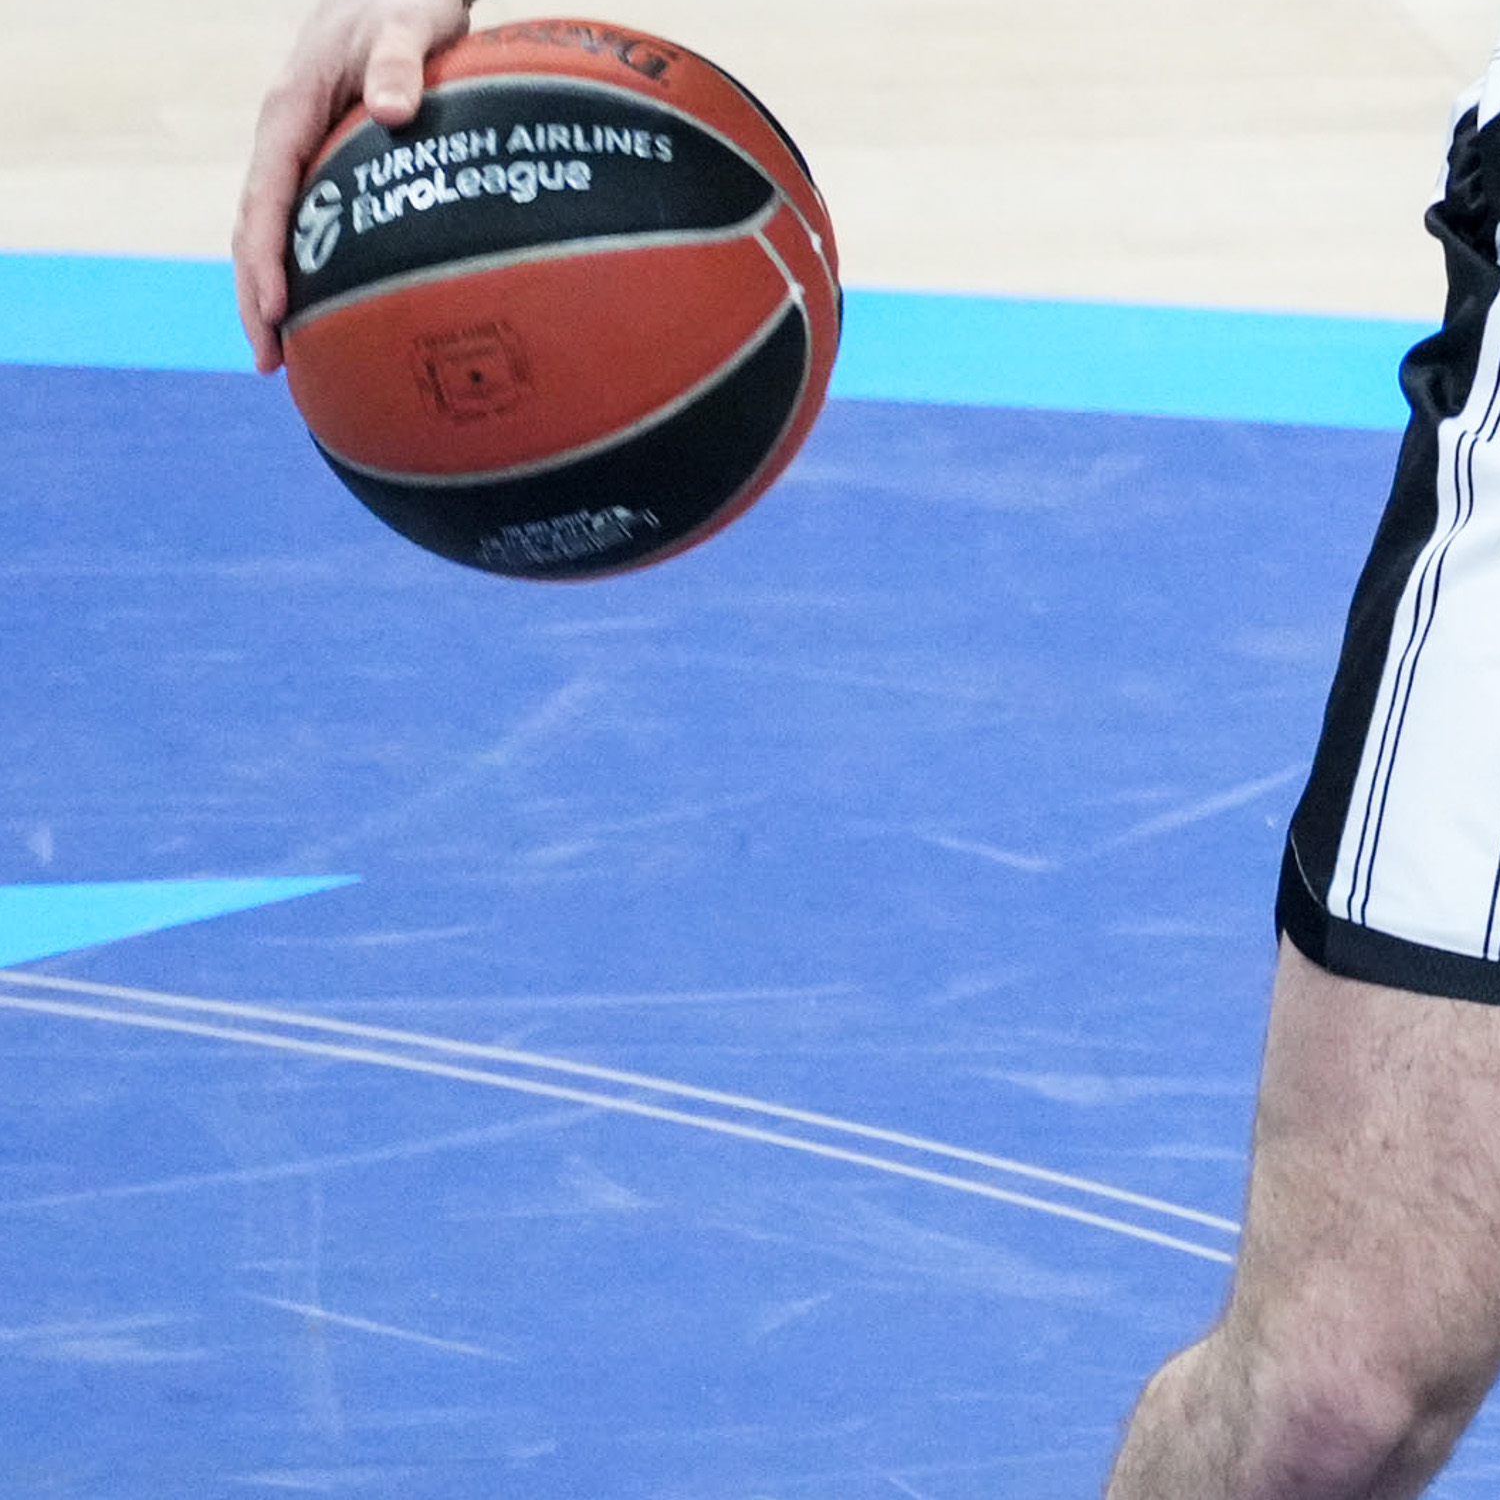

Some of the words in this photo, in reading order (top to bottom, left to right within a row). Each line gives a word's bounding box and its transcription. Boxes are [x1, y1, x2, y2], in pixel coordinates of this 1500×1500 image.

[353, 127, 497, 193] TURKISH
[505, 123, 673, 162] AIRLINES
[352, 160, 592, 234] EuroLeague
